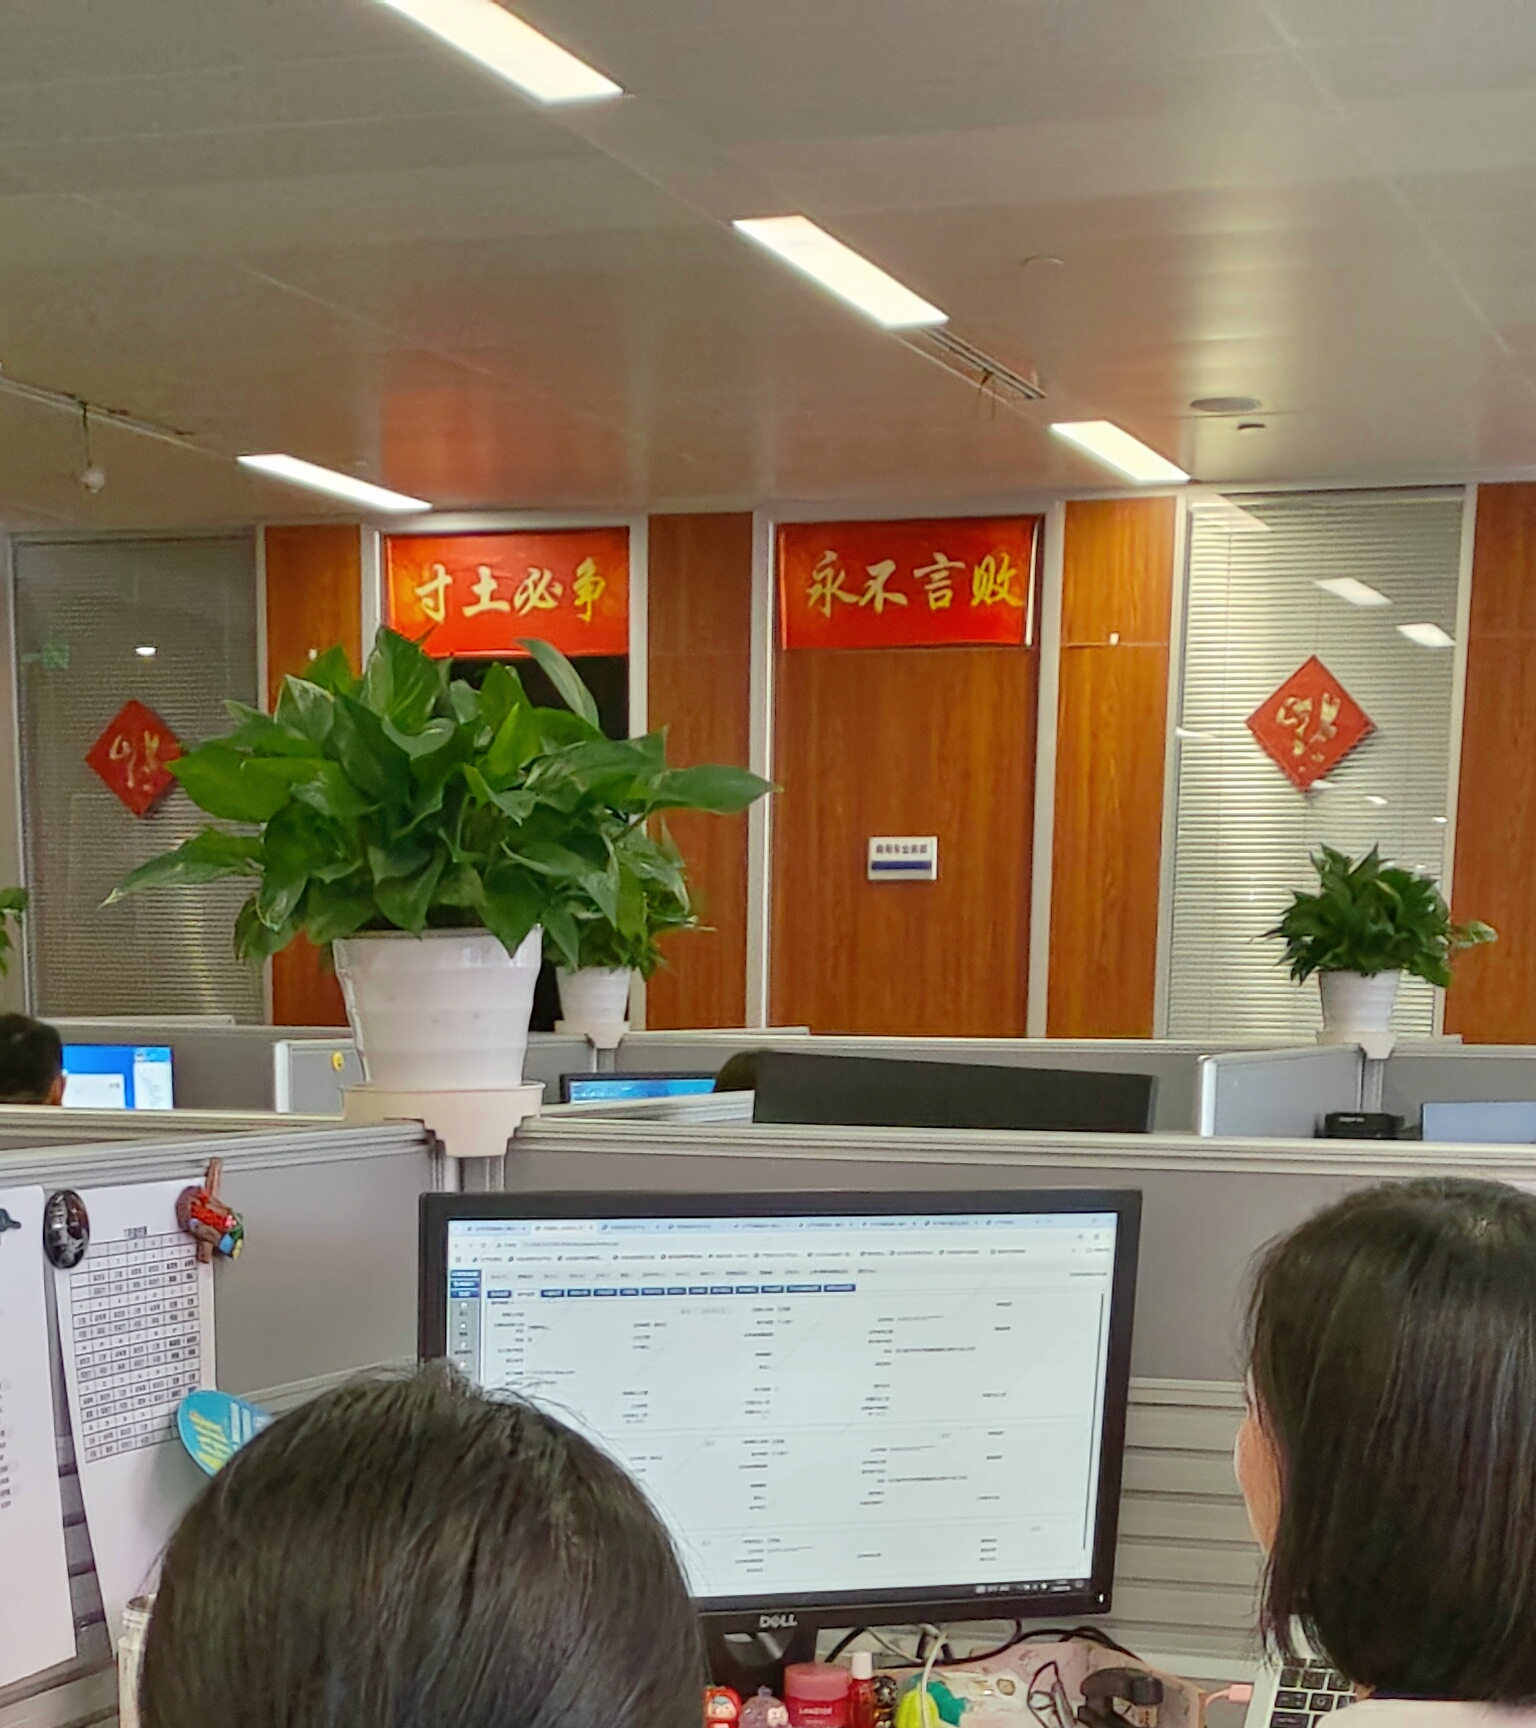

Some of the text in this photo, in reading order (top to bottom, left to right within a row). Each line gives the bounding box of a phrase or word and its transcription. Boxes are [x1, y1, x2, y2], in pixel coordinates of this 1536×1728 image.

[415, 557, 606, 624] 寸土必争
[806, 550, 1024, 619] 永不言败
[759, 1613, 798, 1629] DELL
